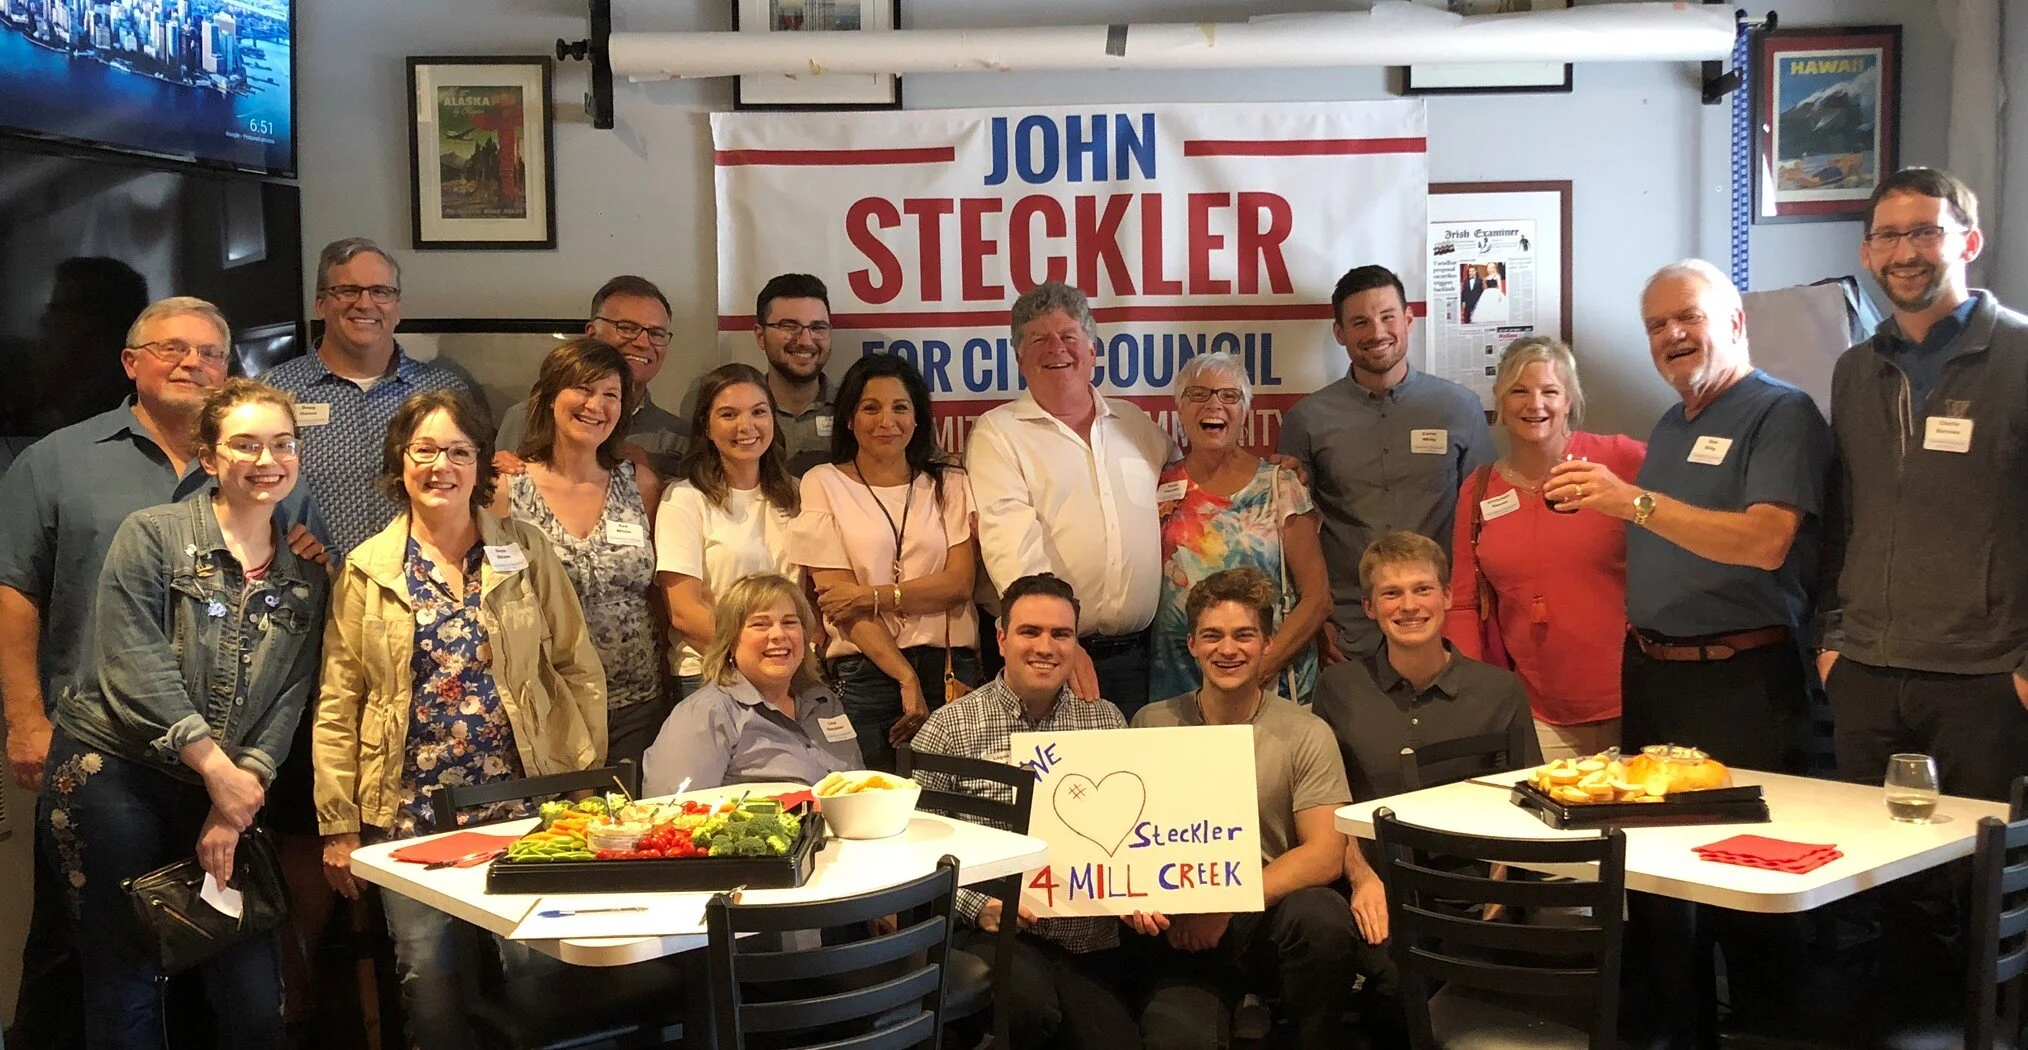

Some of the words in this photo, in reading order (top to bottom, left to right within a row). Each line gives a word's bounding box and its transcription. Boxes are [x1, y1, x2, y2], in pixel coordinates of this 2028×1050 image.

[1790, 58, 1865, 75] HAWAII
[443, 96, 490, 106] ALASKA
[250, 118, 273, 134] 6:51
[984, 113, 1156, 186] JOHN
[845, 192, 1294, 305] STECKLER
[1445, 229, 1470, 240] Irish
[1474, 228, 1519, 239] Examiner
[862, 339, 953, 393] OR
[963, 337, 1029, 393] CI
[1028, 742, 1063, 783] WE
[1128, 819, 1243, 849] Steckler
[1028, 864, 1060, 908] 4
[1068, 862, 1148, 901] MILL
[1158, 860, 1243, 890] CREEK
